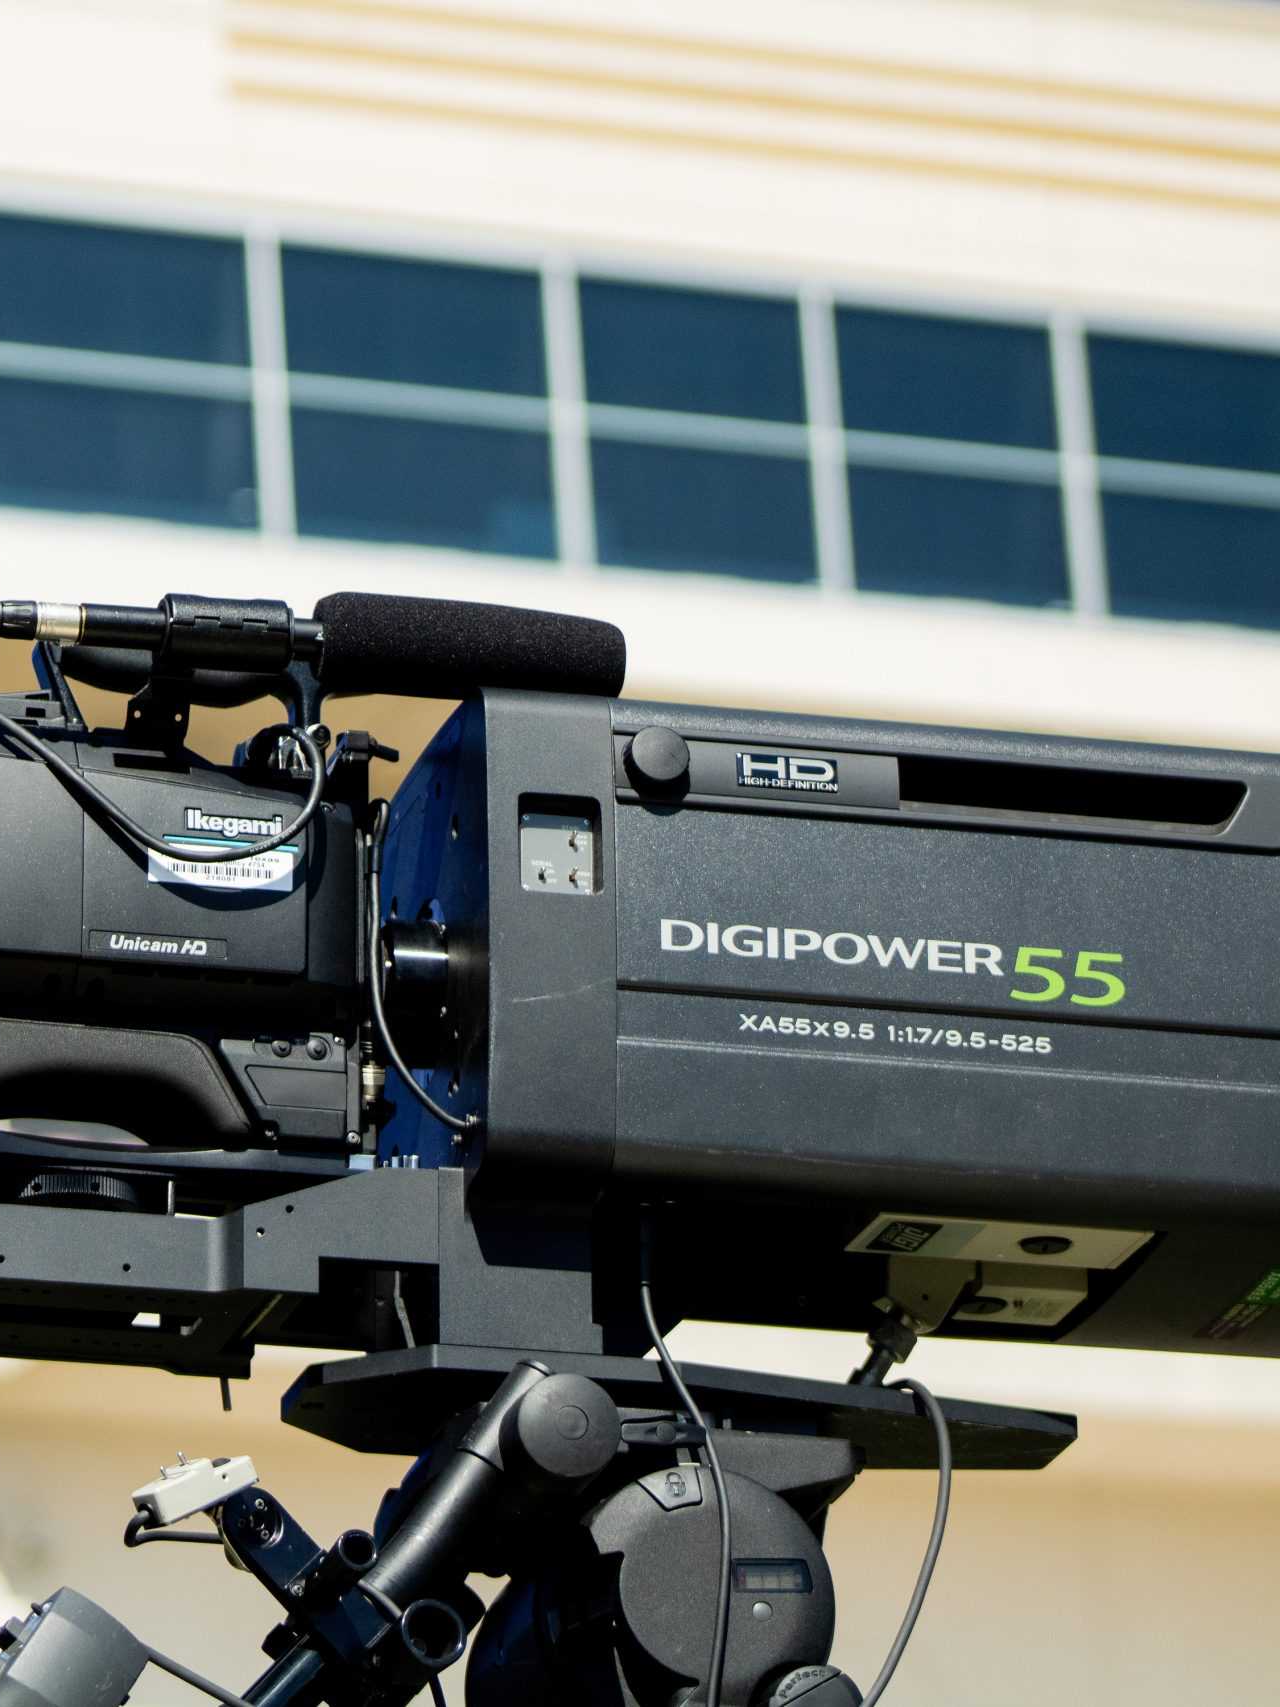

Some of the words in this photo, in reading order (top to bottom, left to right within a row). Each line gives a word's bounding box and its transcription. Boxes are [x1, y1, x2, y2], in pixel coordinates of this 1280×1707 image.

[742, 753, 835, 782] HD
[738, 776, 839, 792] HIGH-DEFINITION
[187, 808, 282, 838] Ikegami
[110, 934, 179, 954] Unicam
[180, 939, 208, 956] HD
[659, 918, 1005, 976] DIGIPOWER
[1009, 945, 1127, 1007] 55
